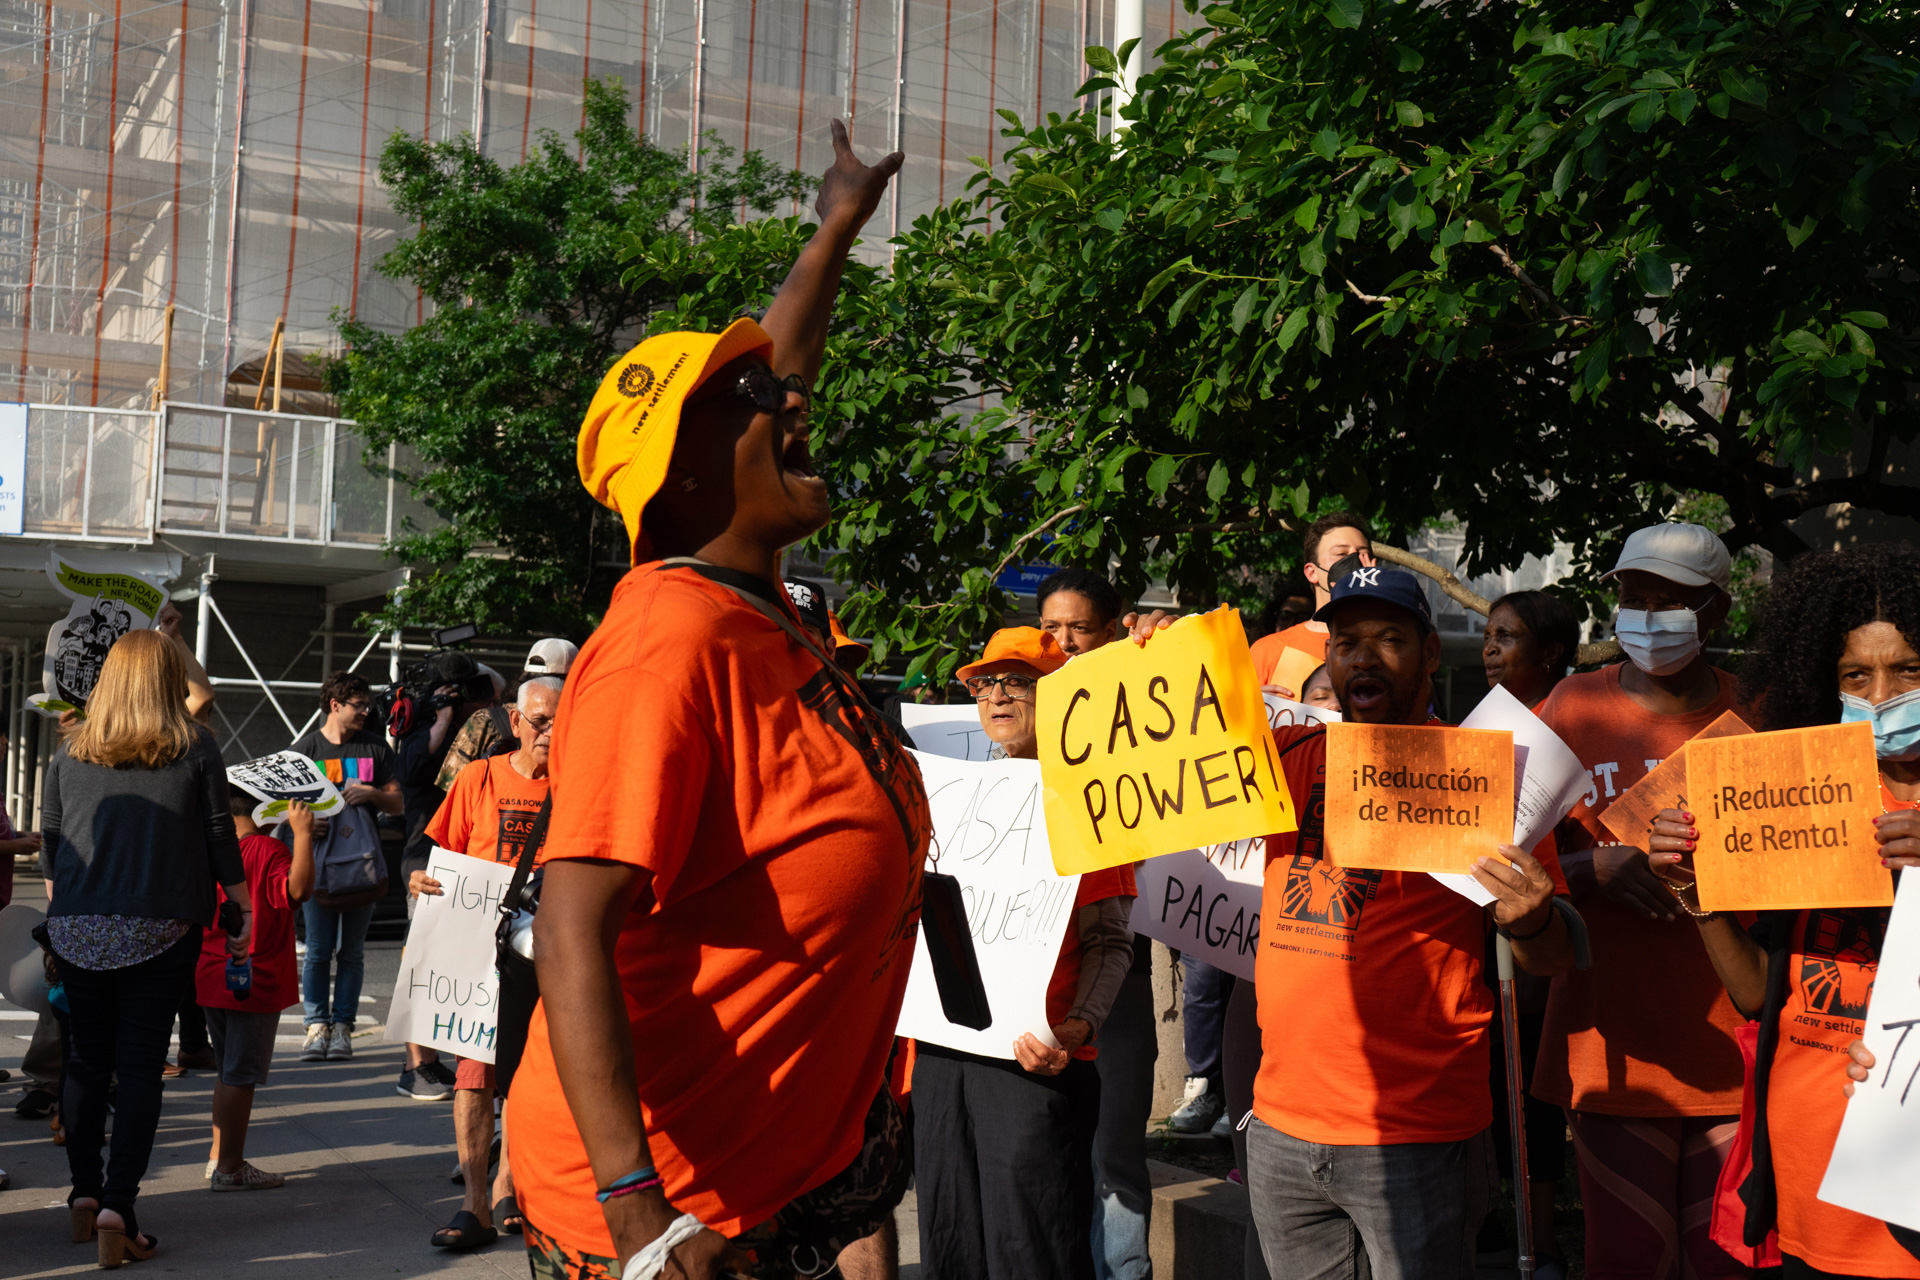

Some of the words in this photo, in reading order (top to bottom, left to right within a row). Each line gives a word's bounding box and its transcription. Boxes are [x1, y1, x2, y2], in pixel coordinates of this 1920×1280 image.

[632, 410, 649, 435] new
[648, 352, 690, 408] settlement
[68, 573, 103, 587] MAKE
[104, 577, 128, 588] THE
[129, 581, 160, 604] ROAD
[1348, 568, 1381, 588] NY
[110, 589, 133, 599] NEW
[134, 594, 155, 613] YORK
[1060, 663, 1228, 766] CASA
[1084, 734, 1286, 844] POWER!
[1353, 764, 1488, 793] ¡Reducción
[499, 798, 521, 806] CASA
[1713, 774, 1853, 819] ¡Reducción
[1358, 798, 1389, 822] de
[1397, 800, 1480, 828] Renta!
[1724, 826, 1754, 853] de
[1761, 819, 1849, 851] Renta!
[1161, 875, 1260, 960] PAGAR
[1276, 923, 1293, 932] new
[1294, 925, 1355, 943] settlement
[433, 1011, 497, 1051] HUM
[1794, 1015, 1821, 1028] new
[1824, 1021, 1866, 1036] settle
